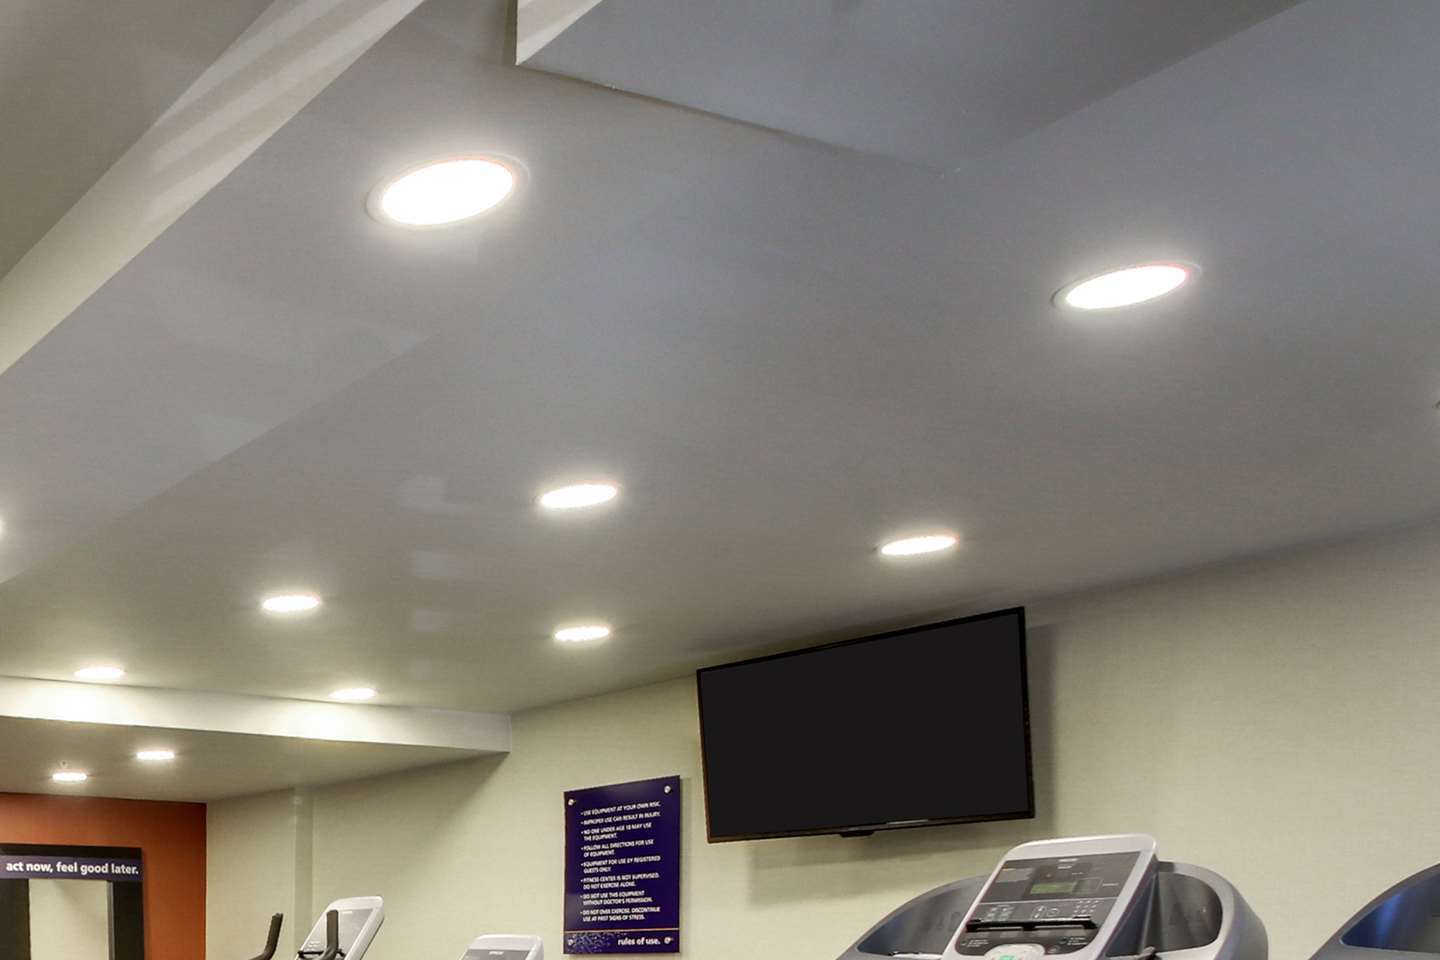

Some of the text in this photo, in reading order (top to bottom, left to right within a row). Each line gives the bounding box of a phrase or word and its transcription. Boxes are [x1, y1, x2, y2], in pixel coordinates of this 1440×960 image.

[5, 861, 140, 876] act now, feel good later.
[617, 937, 635, 946] rules
[636, 937, 646, 945] of
